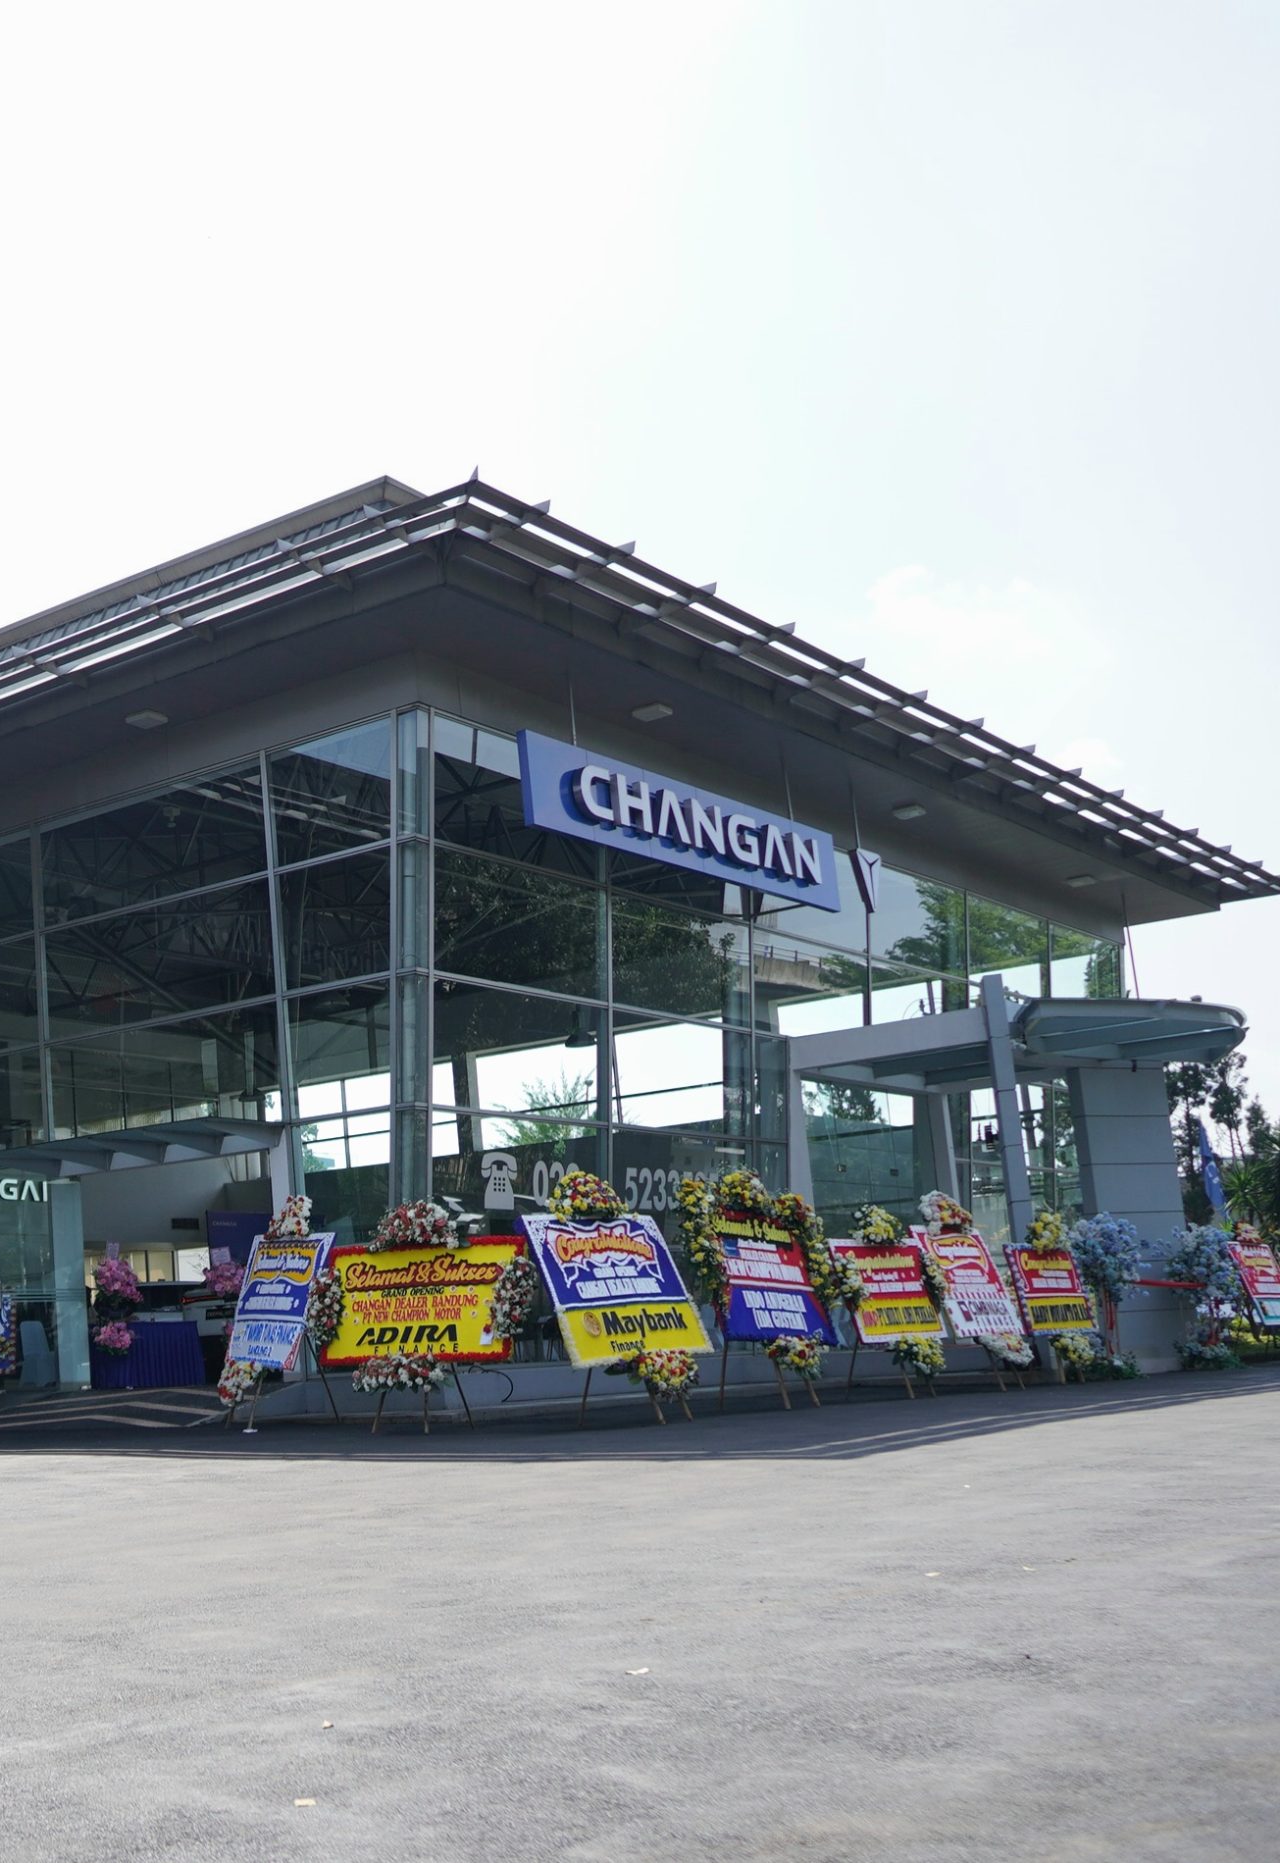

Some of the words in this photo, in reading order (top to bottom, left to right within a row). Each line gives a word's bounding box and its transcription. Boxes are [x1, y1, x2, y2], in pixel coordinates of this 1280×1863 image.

[573, 765, 822, 885] CHANGAN
[346, 1262, 415, 1289] Selamat
[416, 1262, 433, 1283] &
[432, 1256, 497, 1282] Sukses
[381, 1289, 407, 1298] GRAND
[410, 1287, 445, 1297] OPENING
[352, 1299, 391, 1312] CHANGAN
[394, 1297, 428, 1310] DEALER
[432, 1295, 479, 1308] BANDUNG
[362, 1311, 373, 1324] PT
[374, 1310, 388, 1323] NEW
[391, 1309, 429, 1322] CHAMPION
[434, 1307, 462, 1320] MOTOR
[601, 1308, 688, 1338] Maybank
[355, 1324, 458, 1347] ADIRA
[374, 1343, 459, 1354] FINANCE
[610, 1339, 646, 1353] Finance
